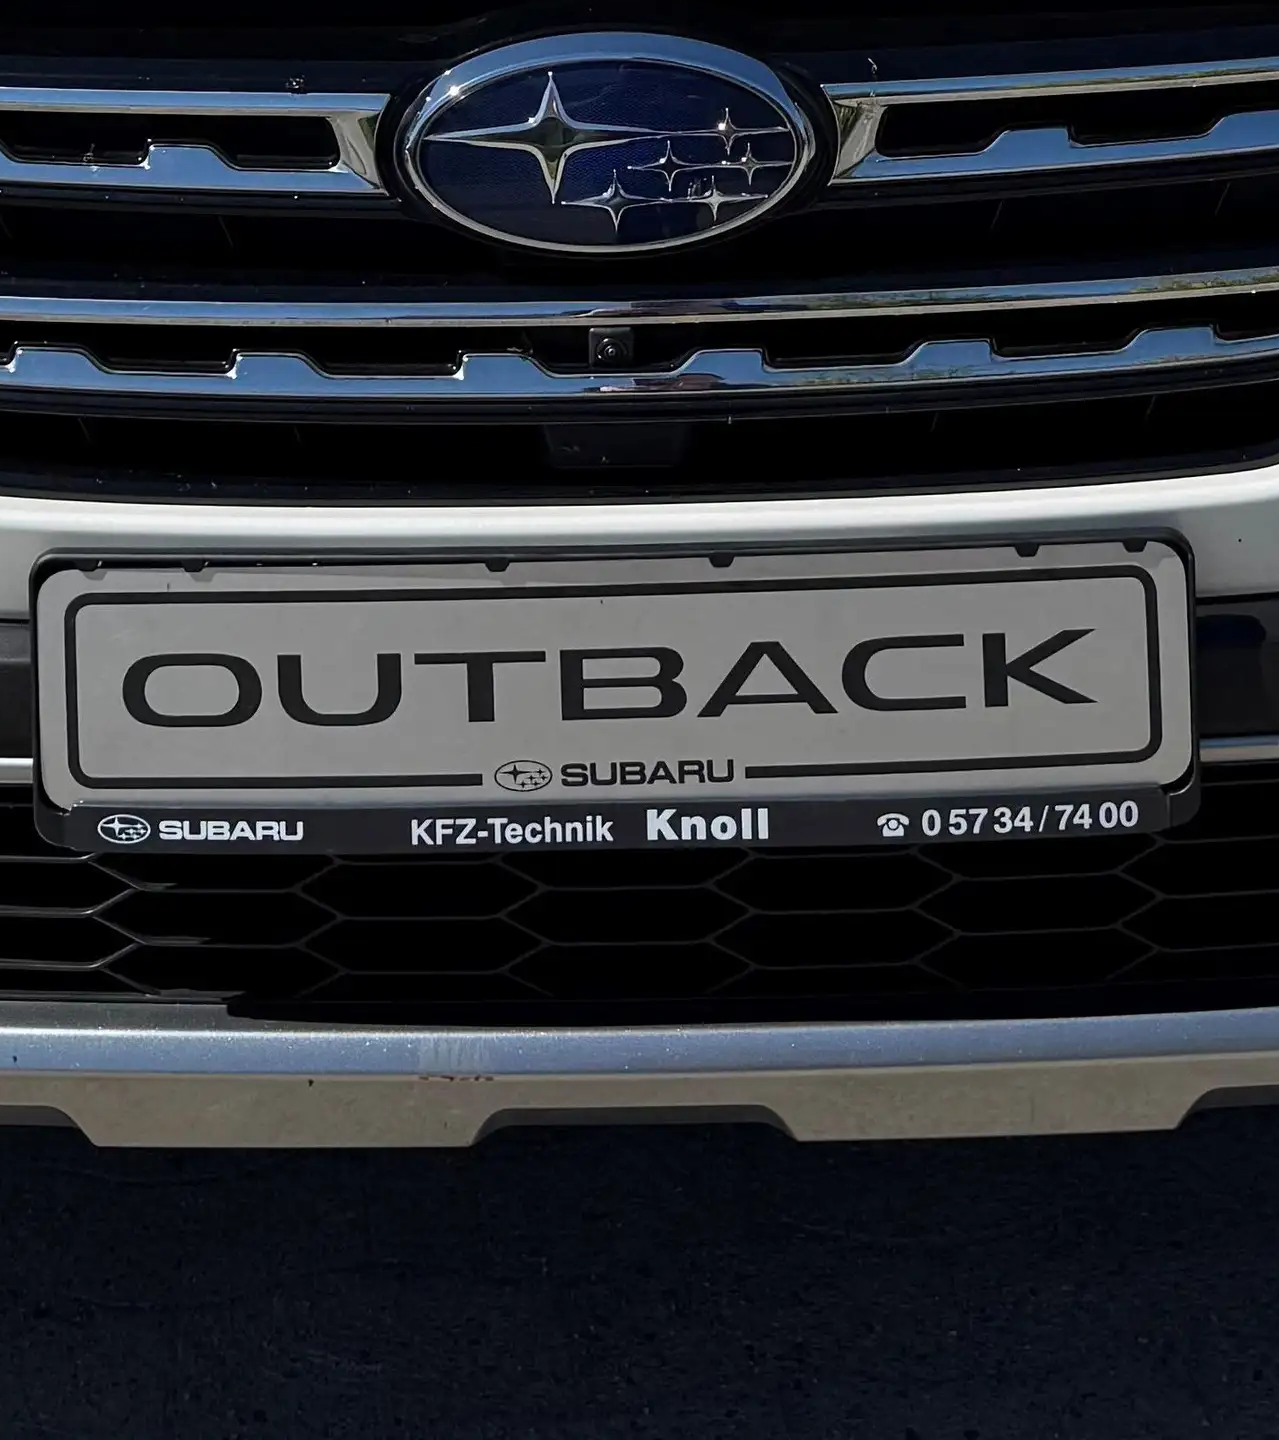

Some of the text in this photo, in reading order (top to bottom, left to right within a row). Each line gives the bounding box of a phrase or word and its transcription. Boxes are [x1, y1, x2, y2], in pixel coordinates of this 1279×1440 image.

[121, 627, 1099, 729] OUTBACK
[560, 757, 736, 787] SUBARU
[157, 819, 305, 843] SUBARU
[410, 814, 615, 847] KFZ-Technik
[645, 806, 770, 843] Knoll
